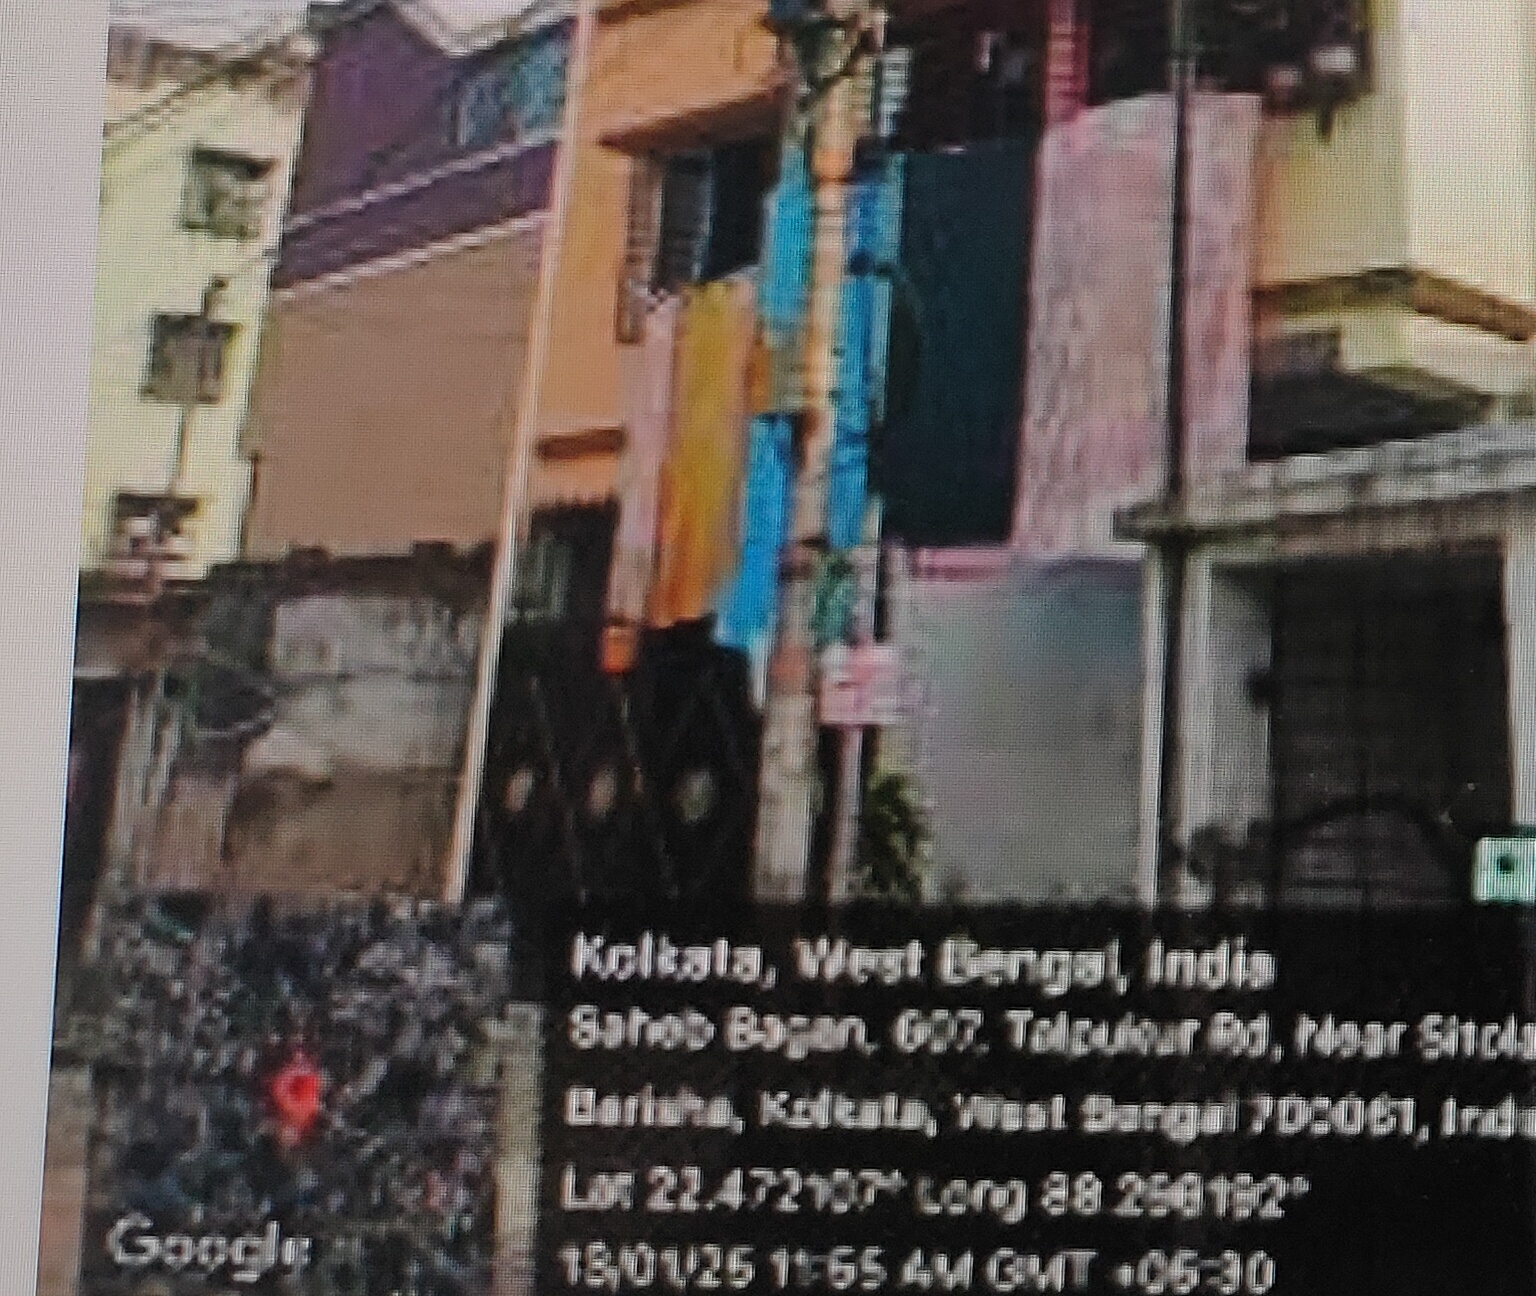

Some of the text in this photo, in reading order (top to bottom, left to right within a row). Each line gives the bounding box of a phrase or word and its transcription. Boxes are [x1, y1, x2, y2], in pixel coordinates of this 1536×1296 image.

[570, 932, 1278, 996] Kolkata, West Bengal, India
[1294, 1013, 1408, 1059] Near
[760, 1086, 938, 1139] Kolkata,
[952, 1092, 1068, 1132] West
[1082, 1092, 1238, 1145] Bengal
[560, 1164, 635, 1211] Lat
[915, 1173, 1027, 1225] Long
[105, 1211, 317, 1283] Google
[901, 1247, 974, 1291] AM
[985, 1247, 1098, 1293] GMT
